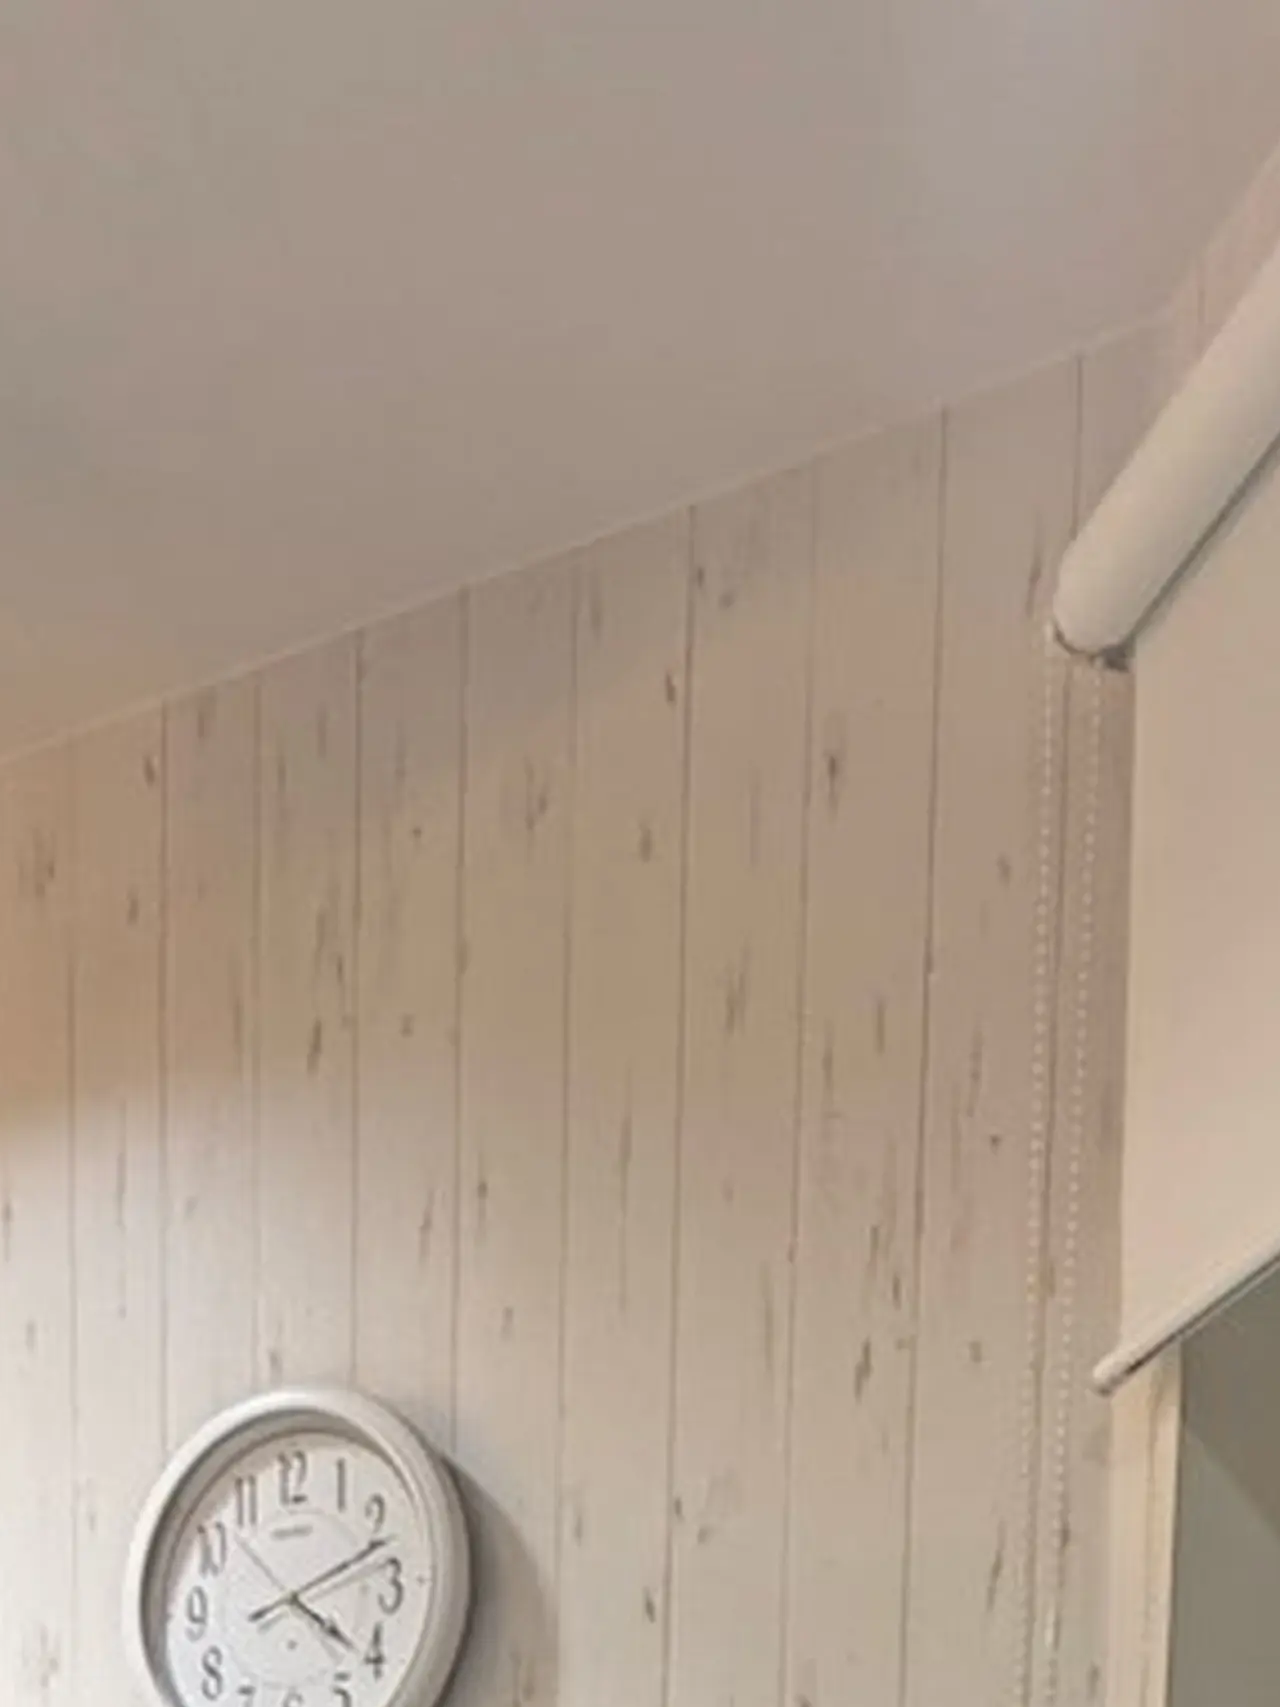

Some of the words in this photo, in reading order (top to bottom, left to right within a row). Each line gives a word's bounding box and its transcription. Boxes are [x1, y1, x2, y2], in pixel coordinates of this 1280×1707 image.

[235, 1475, 258, 1529] 11
[276, 1451, 308, 1505] 12
[336, 1458, 346, 1513] 1
[365, 1494, 386, 1532] 2
[197, 1524, 227, 1576] 10
[378, 1557, 404, 1615] 3
[185, 1586, 209, 1642] 9
[201, 1646, 223, 1700] 8
[364, 1622, 386, 1679] 4
